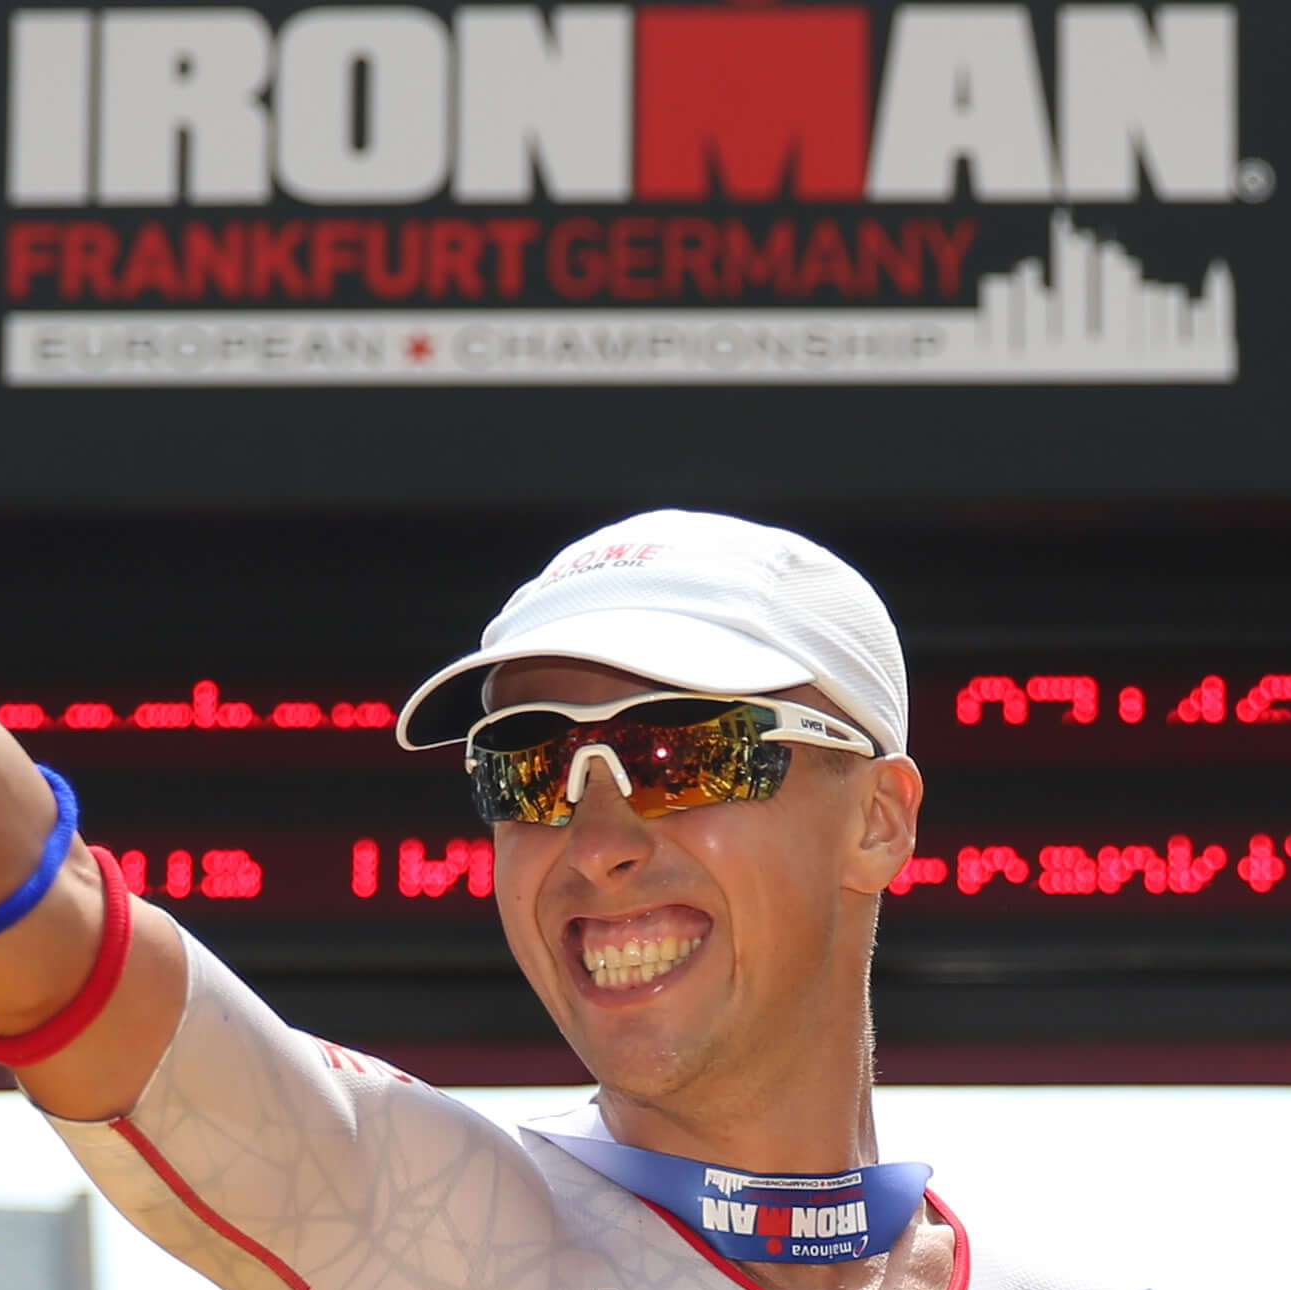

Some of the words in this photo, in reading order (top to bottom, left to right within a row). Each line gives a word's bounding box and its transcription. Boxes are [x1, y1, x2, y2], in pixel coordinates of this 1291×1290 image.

[6, 4, 1238, 205] IRONMAN
[5, 219, 534, 301] FRANKFURT
[546, 219, 977, 300] GERMANY
[33, 325, 385, 372] EUROPEAN
[452, 323, 947, 372] CHAMPIONSHIP
[701, 1197, 868, 1239] IRONMAN
[792, 1241, 852, 1259] mainova
